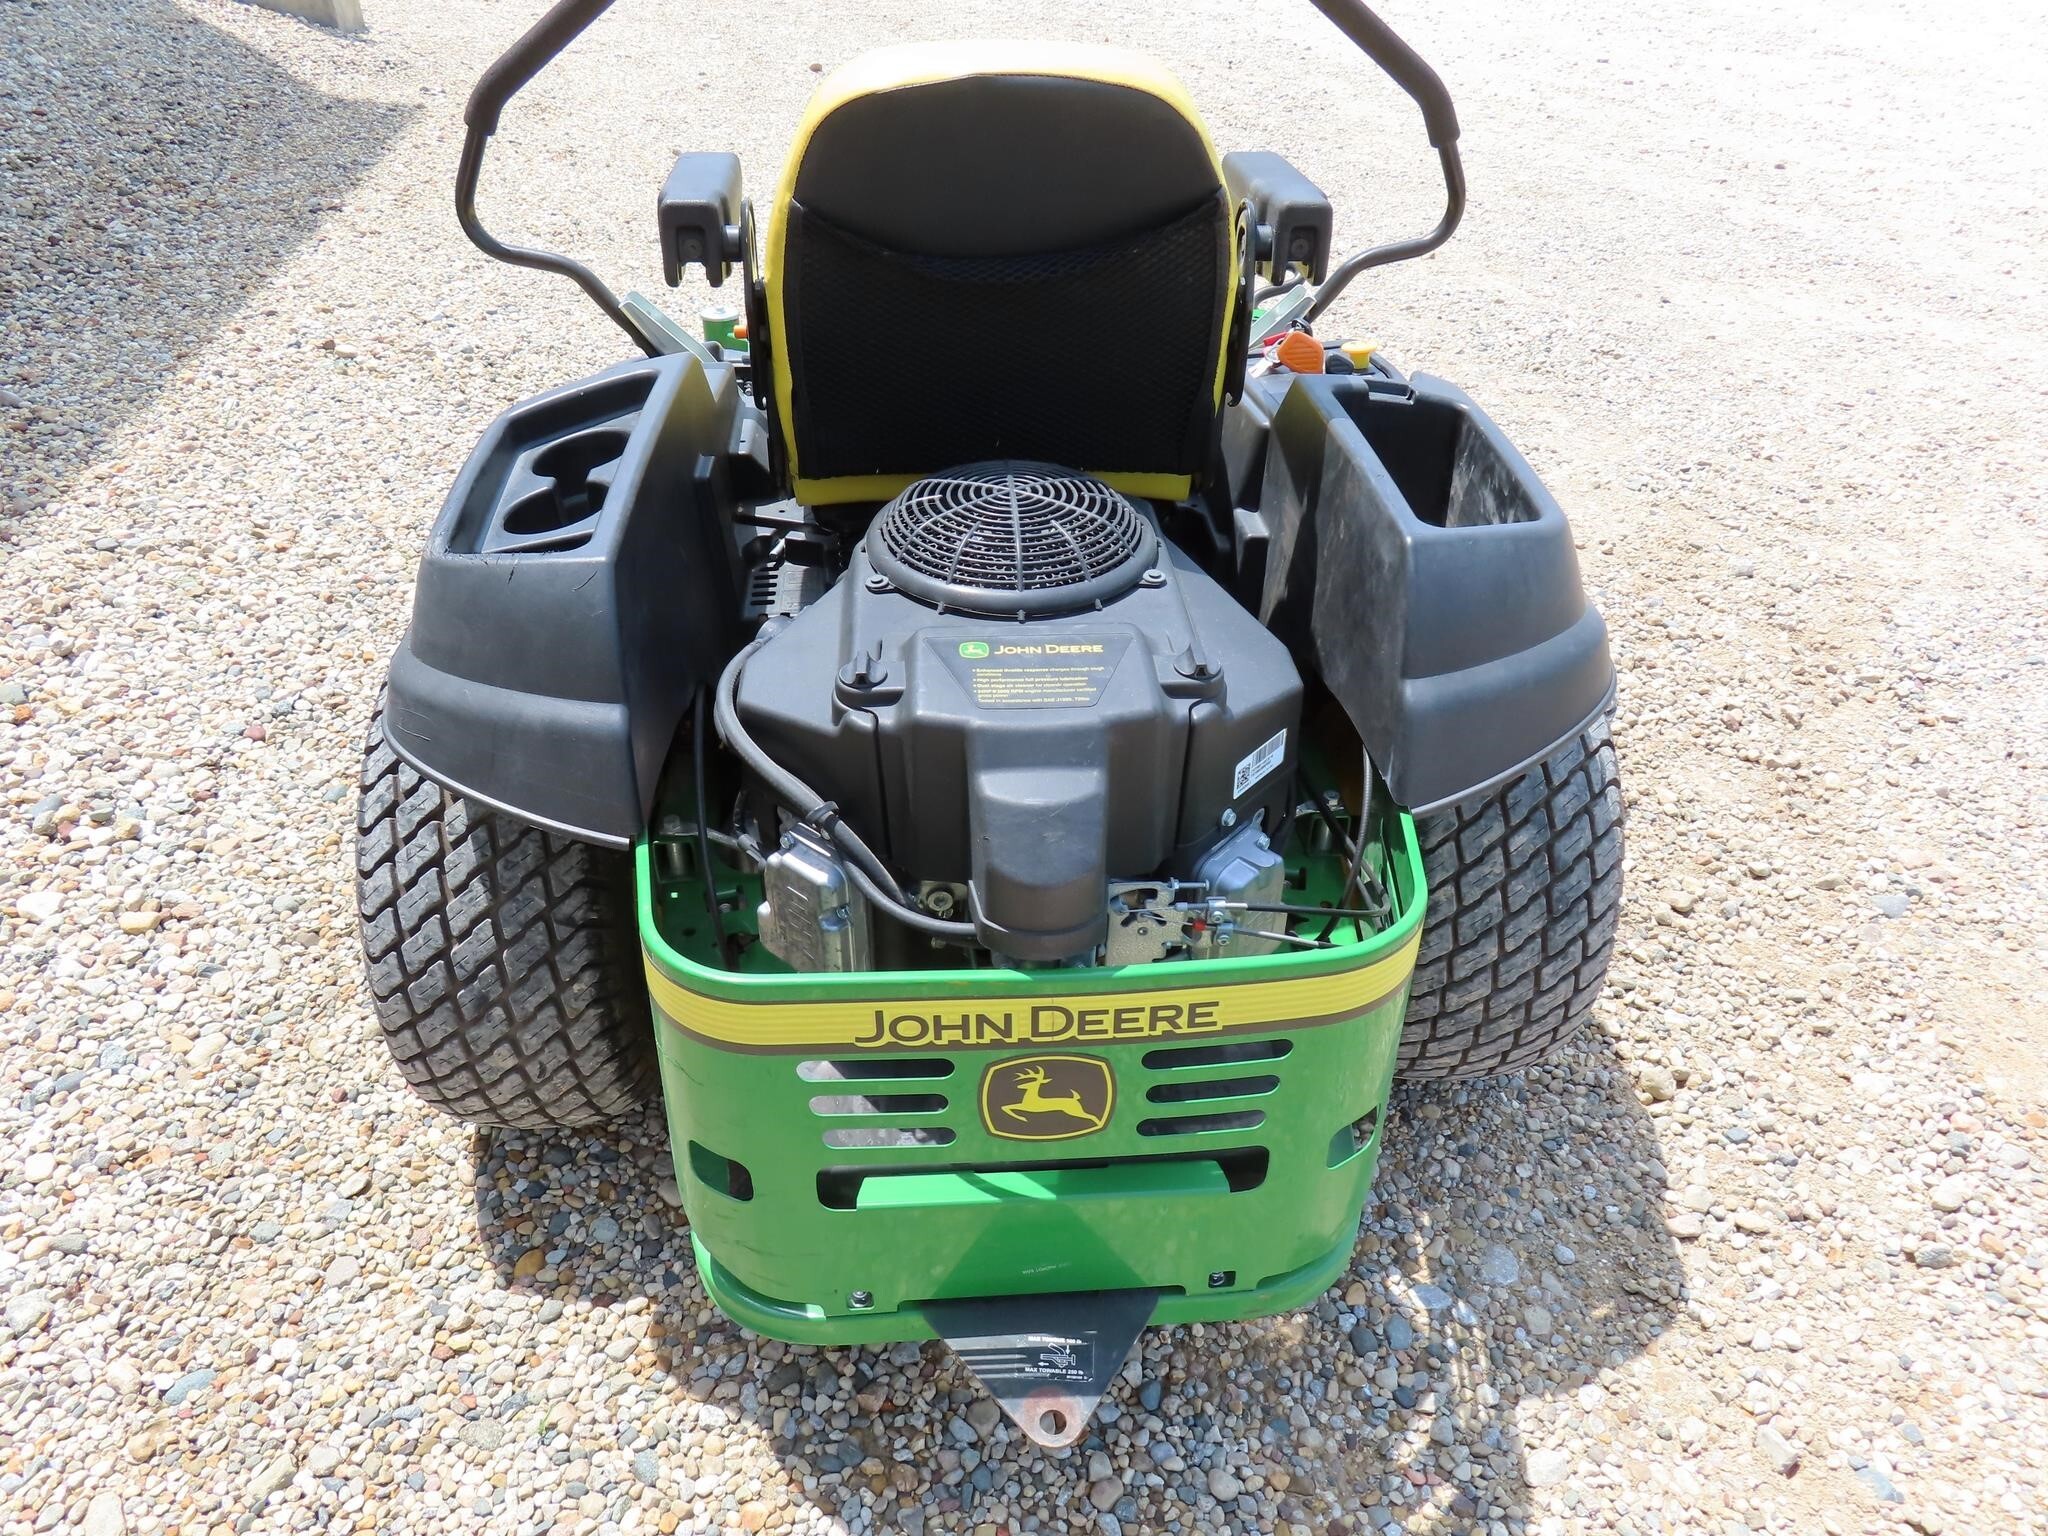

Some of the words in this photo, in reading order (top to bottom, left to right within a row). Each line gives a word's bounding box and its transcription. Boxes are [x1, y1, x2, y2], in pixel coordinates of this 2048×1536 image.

[994, 645, 1042, 655] JOHN
[1045, 644, 1104, 654] DEERE
[854, 1009, 1014, 1043] JOHN
[1030, 1001, 1220, 1040] DEERE
[1039, 1367, 1067, 1375] TOWABLE
